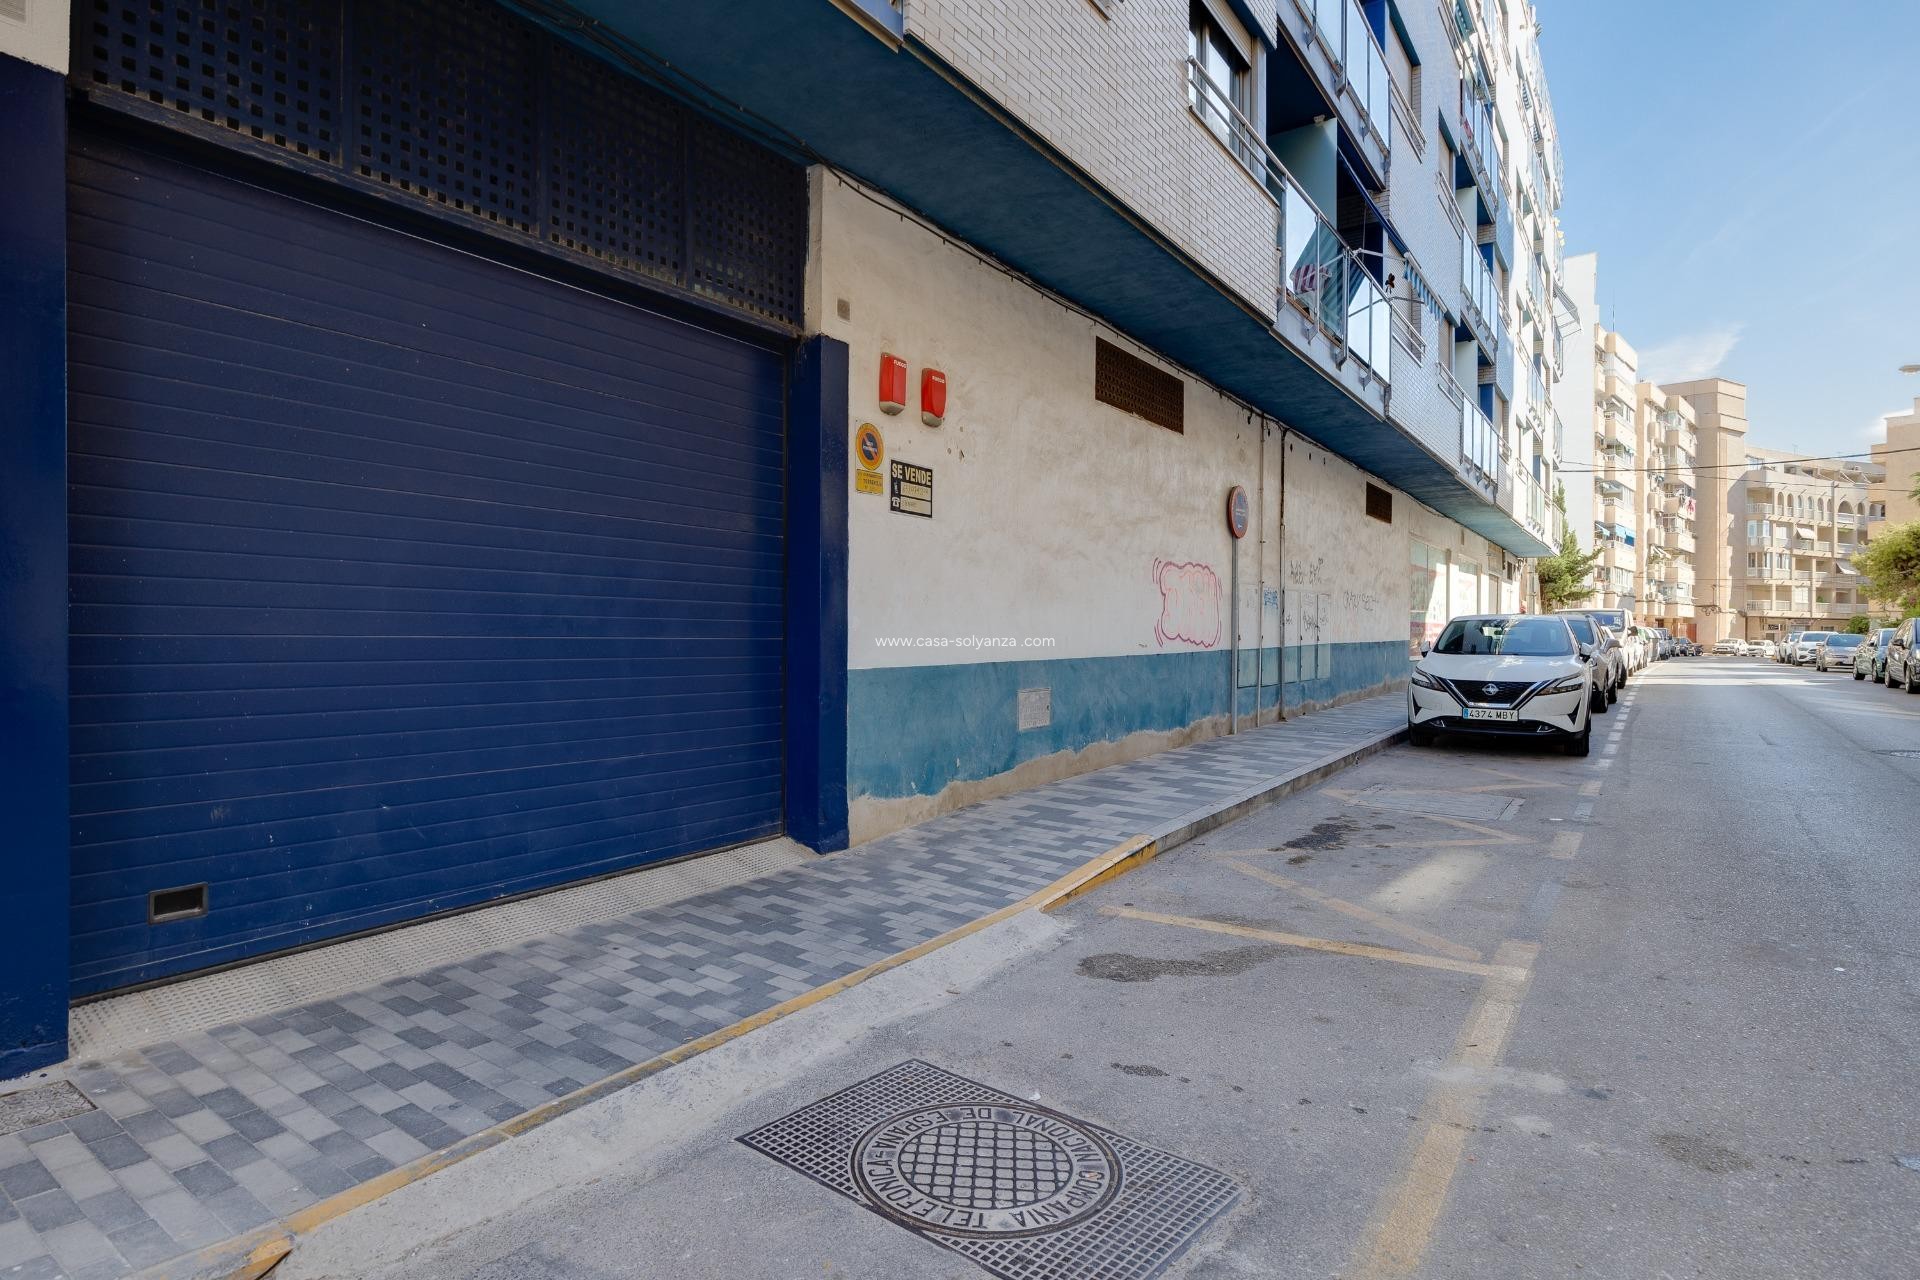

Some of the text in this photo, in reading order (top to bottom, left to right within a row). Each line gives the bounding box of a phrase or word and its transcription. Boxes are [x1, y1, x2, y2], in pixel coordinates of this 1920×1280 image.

[892, 463, 932, 486] SE VENDE
[1469, 709, 1515, 720] 4374 MBY
[871, 1107, 1102, 1163] NACIONAL DE ESPAÑA
[866, 1159, 988, 1230] TELEFONICA
